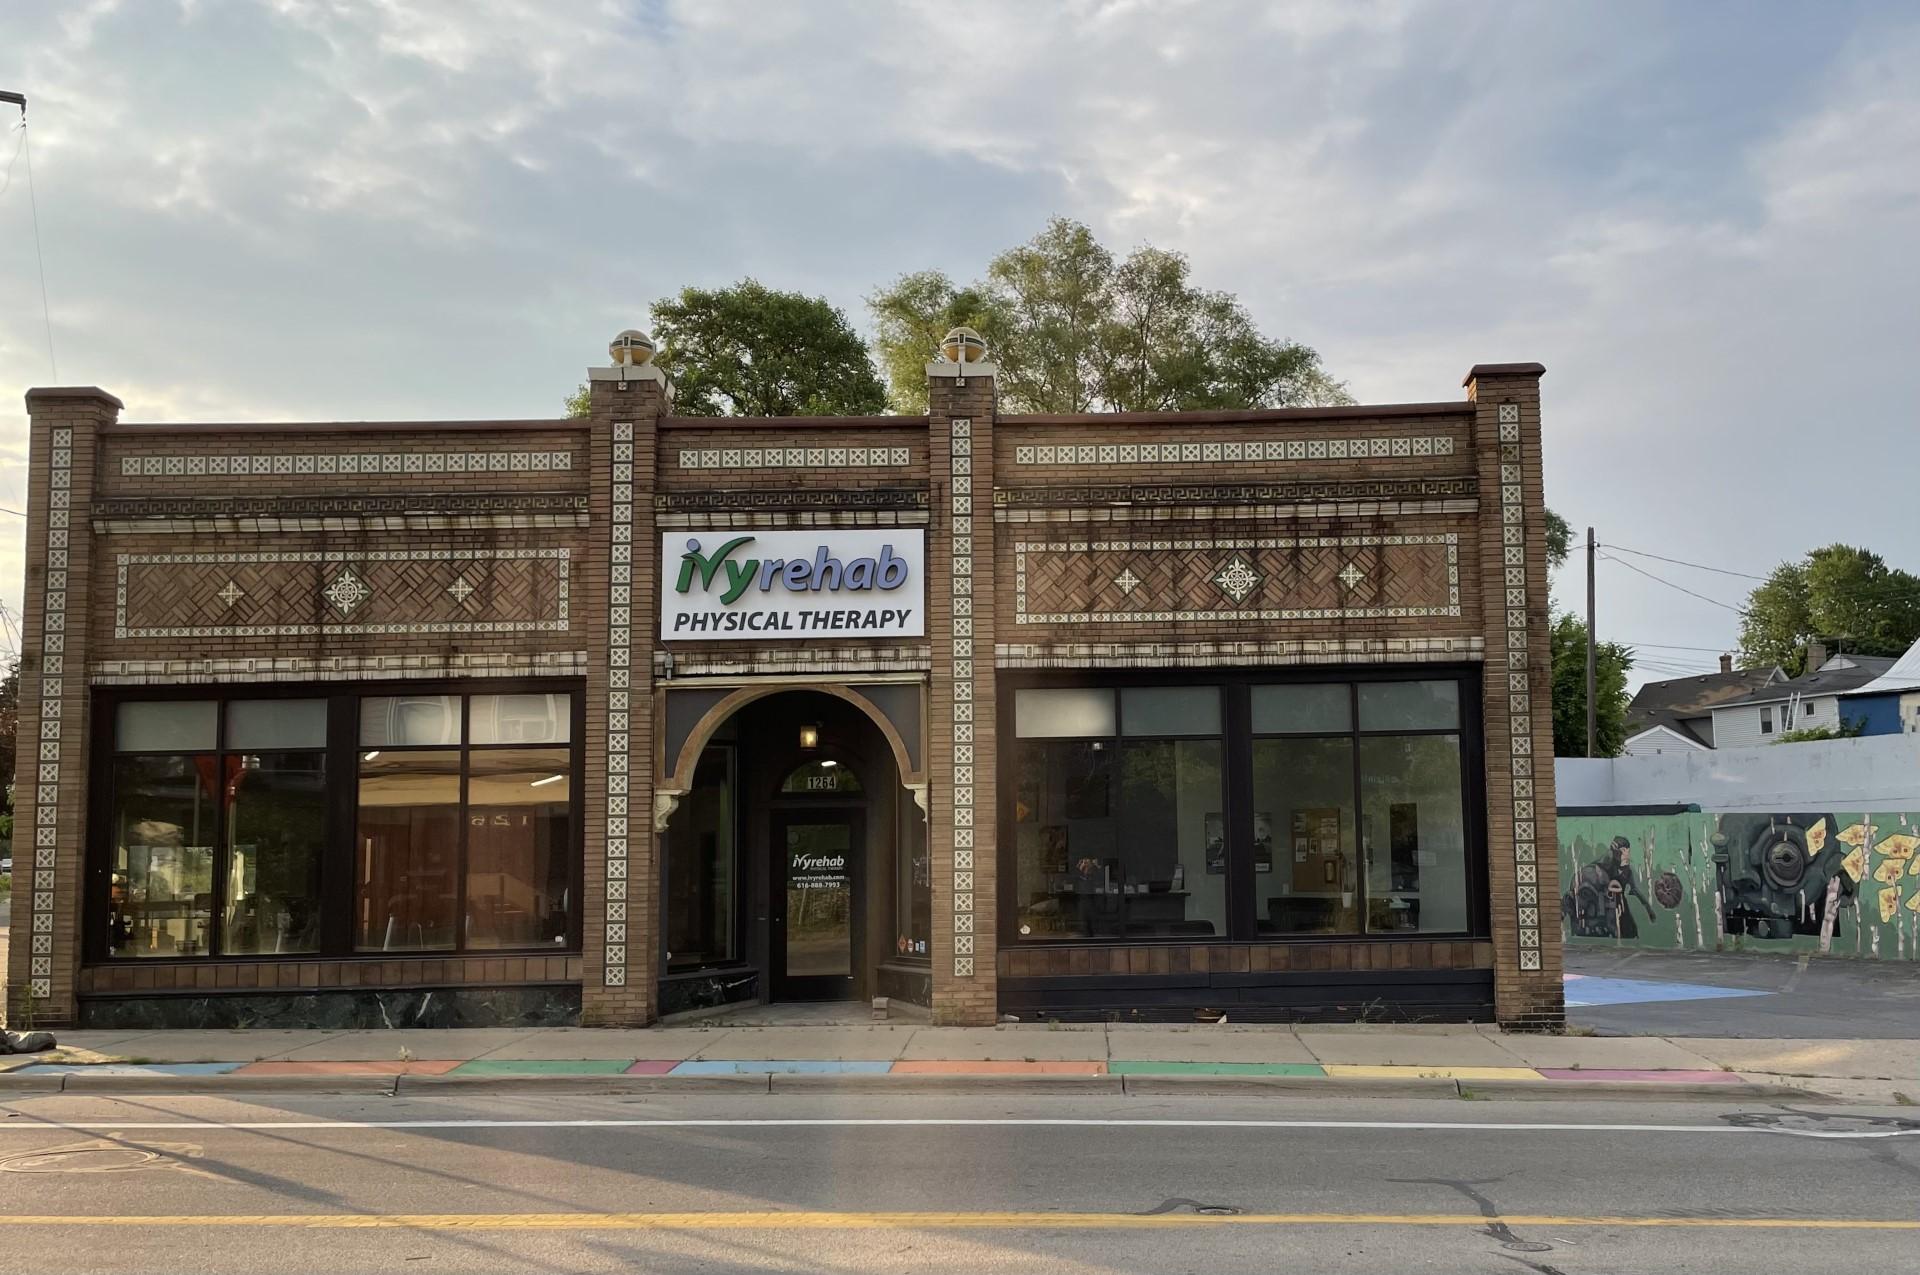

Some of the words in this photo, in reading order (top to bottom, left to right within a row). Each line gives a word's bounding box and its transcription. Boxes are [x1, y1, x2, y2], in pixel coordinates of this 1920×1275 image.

[675, 537, 909, 605] ivyrehab
[674, 611, 794, 631] PHYSICAL
[799, 609, 912, 630] THERAPY
[792, 853, 845, 870] ivyrehab
